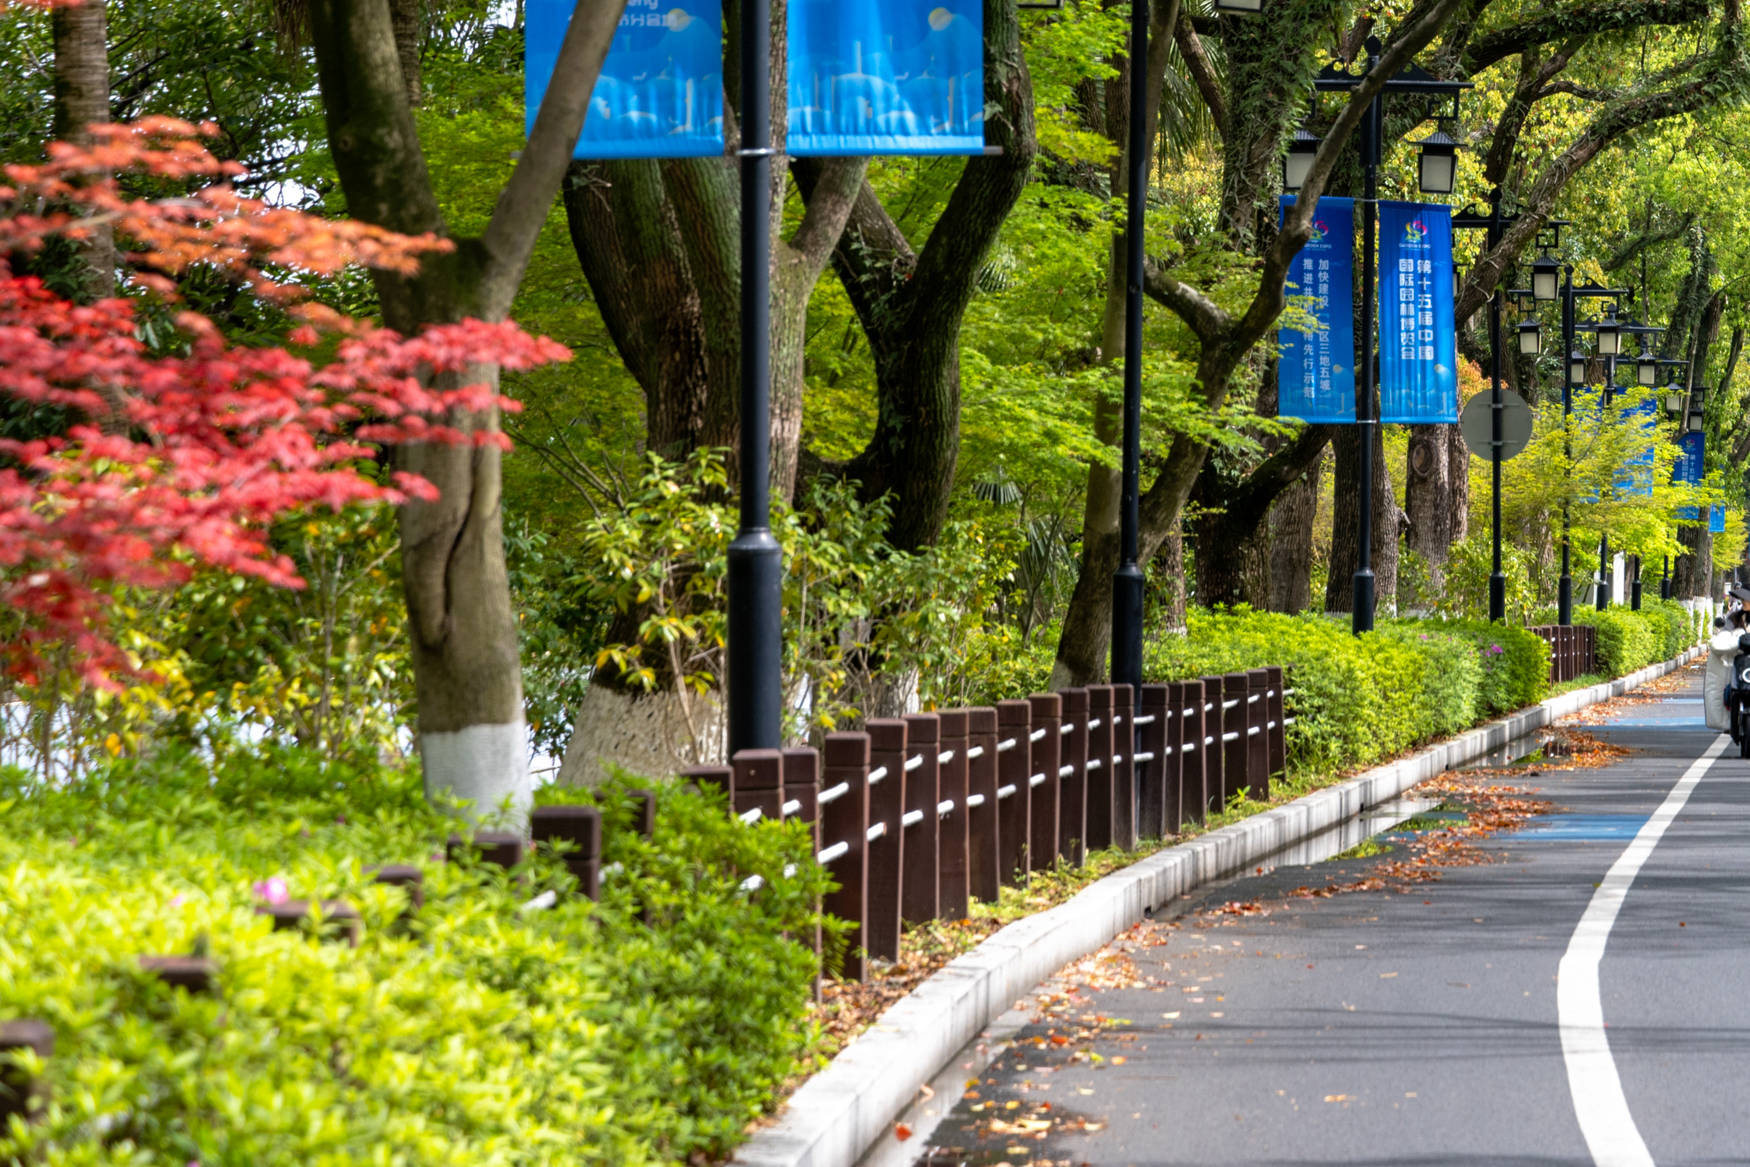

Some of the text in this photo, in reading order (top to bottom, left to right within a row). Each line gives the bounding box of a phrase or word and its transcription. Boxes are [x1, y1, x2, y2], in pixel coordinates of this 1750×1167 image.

[1398, 258, 1416, 360] 国际园林博览会
[1417, 259, 1434, 361] 第十五届中国
